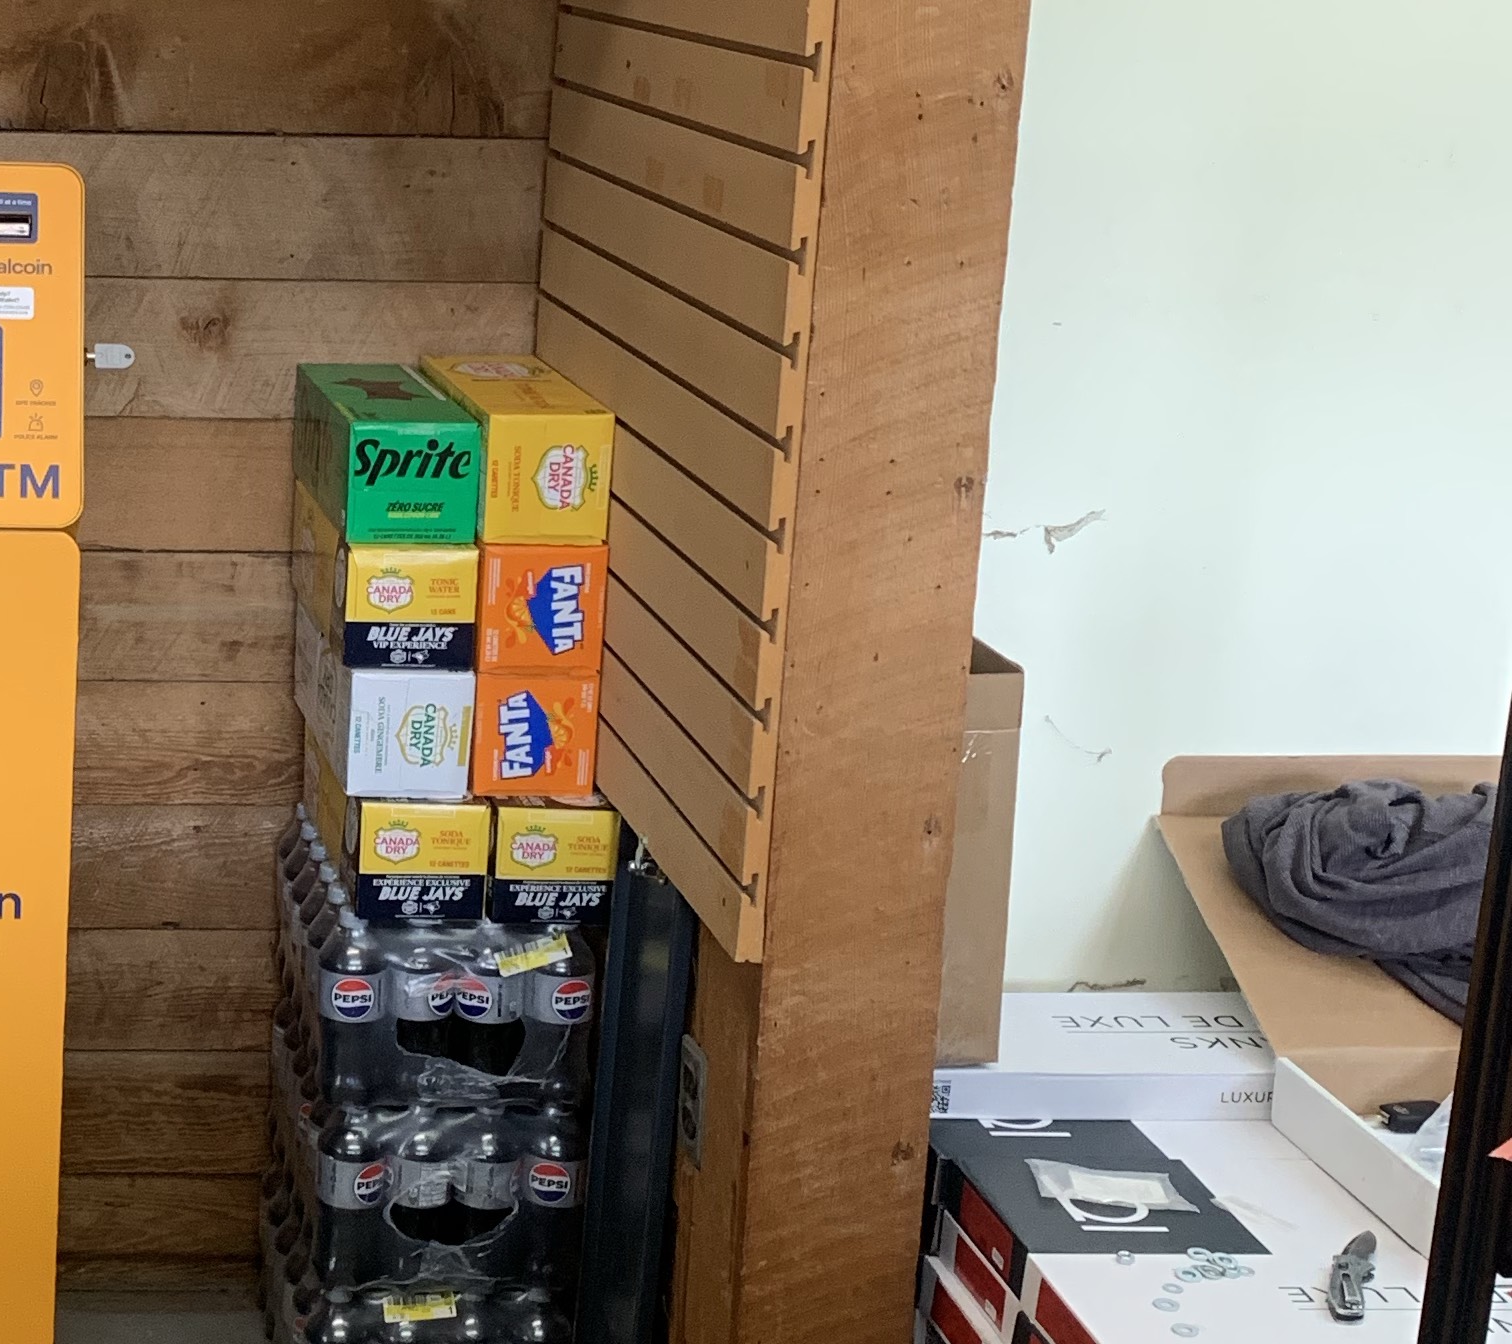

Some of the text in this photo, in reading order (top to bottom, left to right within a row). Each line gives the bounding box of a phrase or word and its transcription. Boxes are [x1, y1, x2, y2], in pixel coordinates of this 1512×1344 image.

[354, 438, 471, 486] Sprite
[511, 445, 522, 513] SODA TONIQUE
[548, 462, 561, 493] DRY
[559, 444, 575, 511] CANADA
[386, 500, 445, 512] ZÉRO SUCRE
[431, 578, 459, 586] TONIC
[366, 586, 413, 594] CANADA
[378, 595, 400, 603] DRY
[550, 566, 584, 654] FANTA
[366, 626, 455, 642] BLUE JAYS
[373, 641, 447, 650] VIP EXPERIENCE
[353, 723, 361, 753] CANETTES
[374, 696, 386, 774] SODA GINGEMBRE
[409, 720, 423, 751] DRY
[419, 703, 437, 767] CANADA
[499, 692, 534, 778] FANTA
[374, 837, 420, 845] CANADA
[431, 837, 471, 846] TONIQUE
[511, 842, 557, 851] CANADA
[385, 846, 407, 854] DRY
[521, 851, 544, 859] DRY
[425, 879, 471, 887] EXCLUSIVE
[378, 887, 465, 901] BLUE JAYS
[515, 892, 601, 906] BLUE JAYS
[334, 992, 372, 1004] PEPSI
[1051, 1015, 1245, 1029] DE LUXE
[1171, 1036, 1266, 1049] NKS
[531, 1177, 569, 1190] PEPSI
